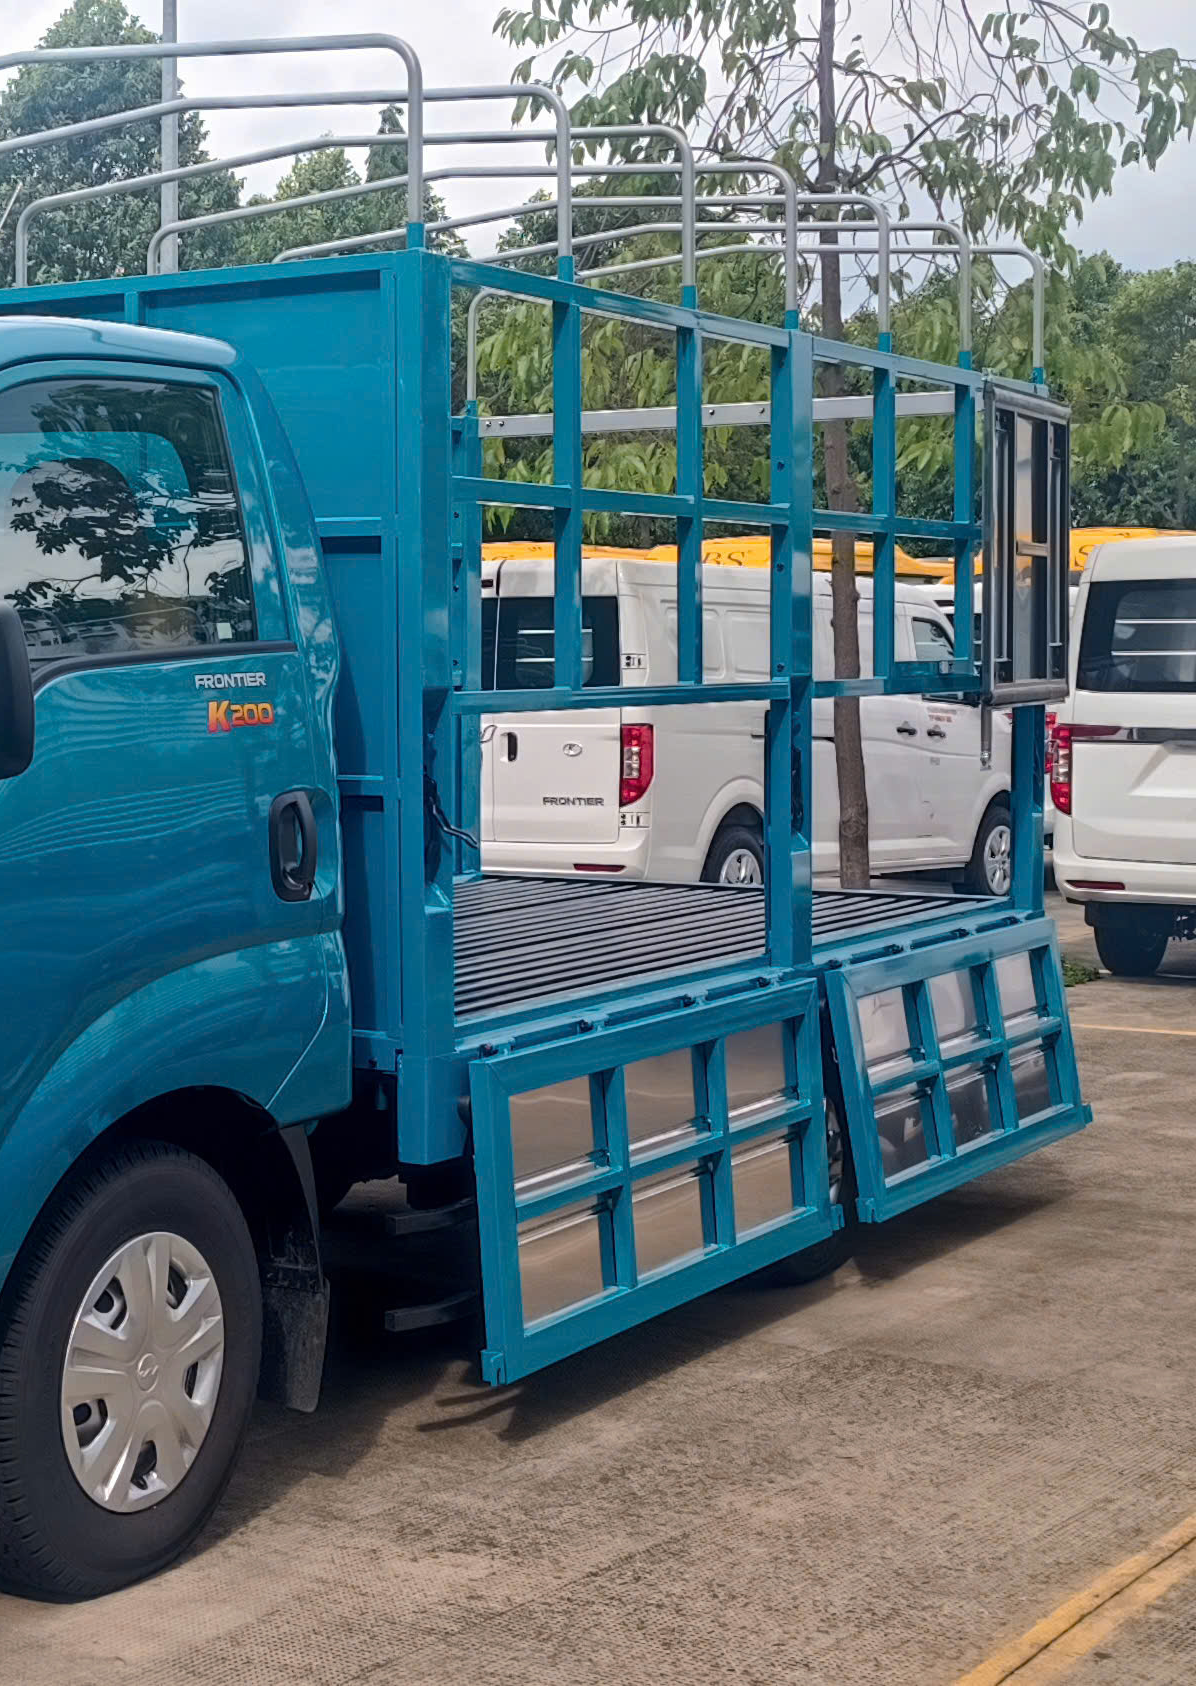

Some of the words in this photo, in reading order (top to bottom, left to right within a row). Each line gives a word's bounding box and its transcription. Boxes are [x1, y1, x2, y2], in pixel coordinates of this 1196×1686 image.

[194, 671, 267, 690] FRONTIER
[207, 700, 275, 733] K200
[542, 796, 605, 807] FRONTIER
